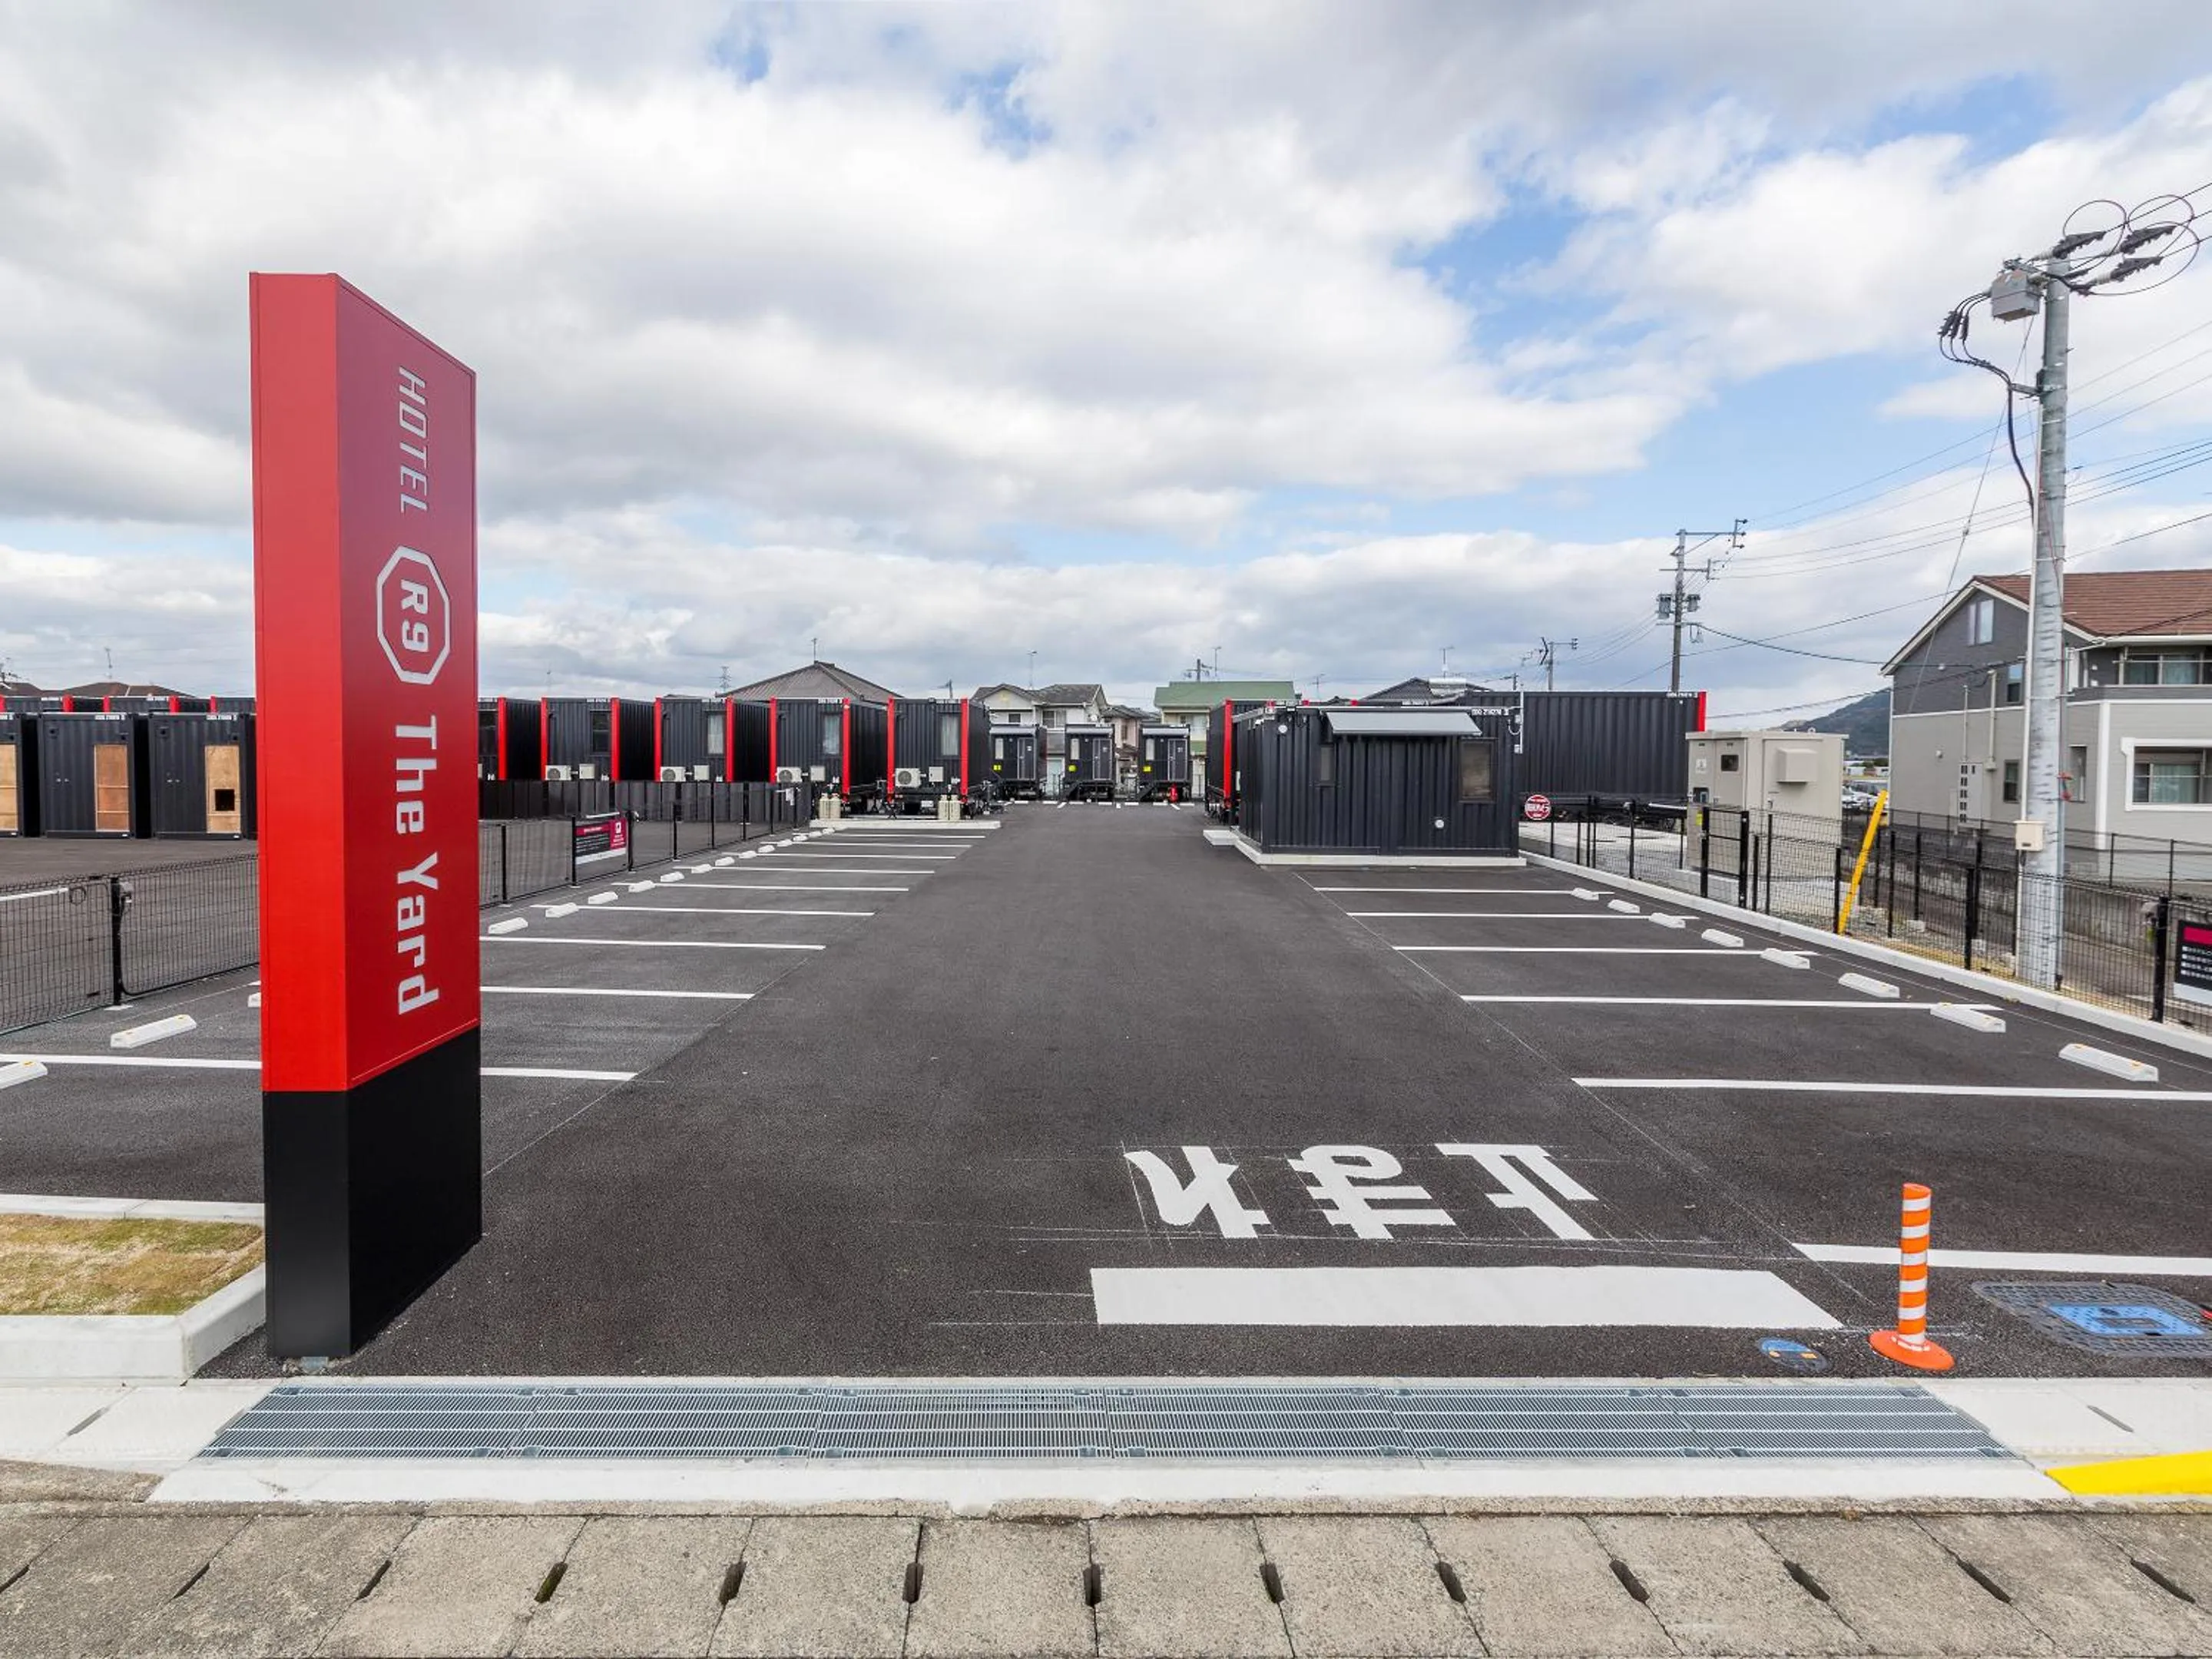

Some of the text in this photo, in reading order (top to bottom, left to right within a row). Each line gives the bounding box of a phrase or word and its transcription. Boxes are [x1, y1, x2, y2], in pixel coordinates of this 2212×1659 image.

[396, 365, 439, 1015] HOTEL R9 The Yard
[1124, 1143, 1599, 1240] 止まれ
